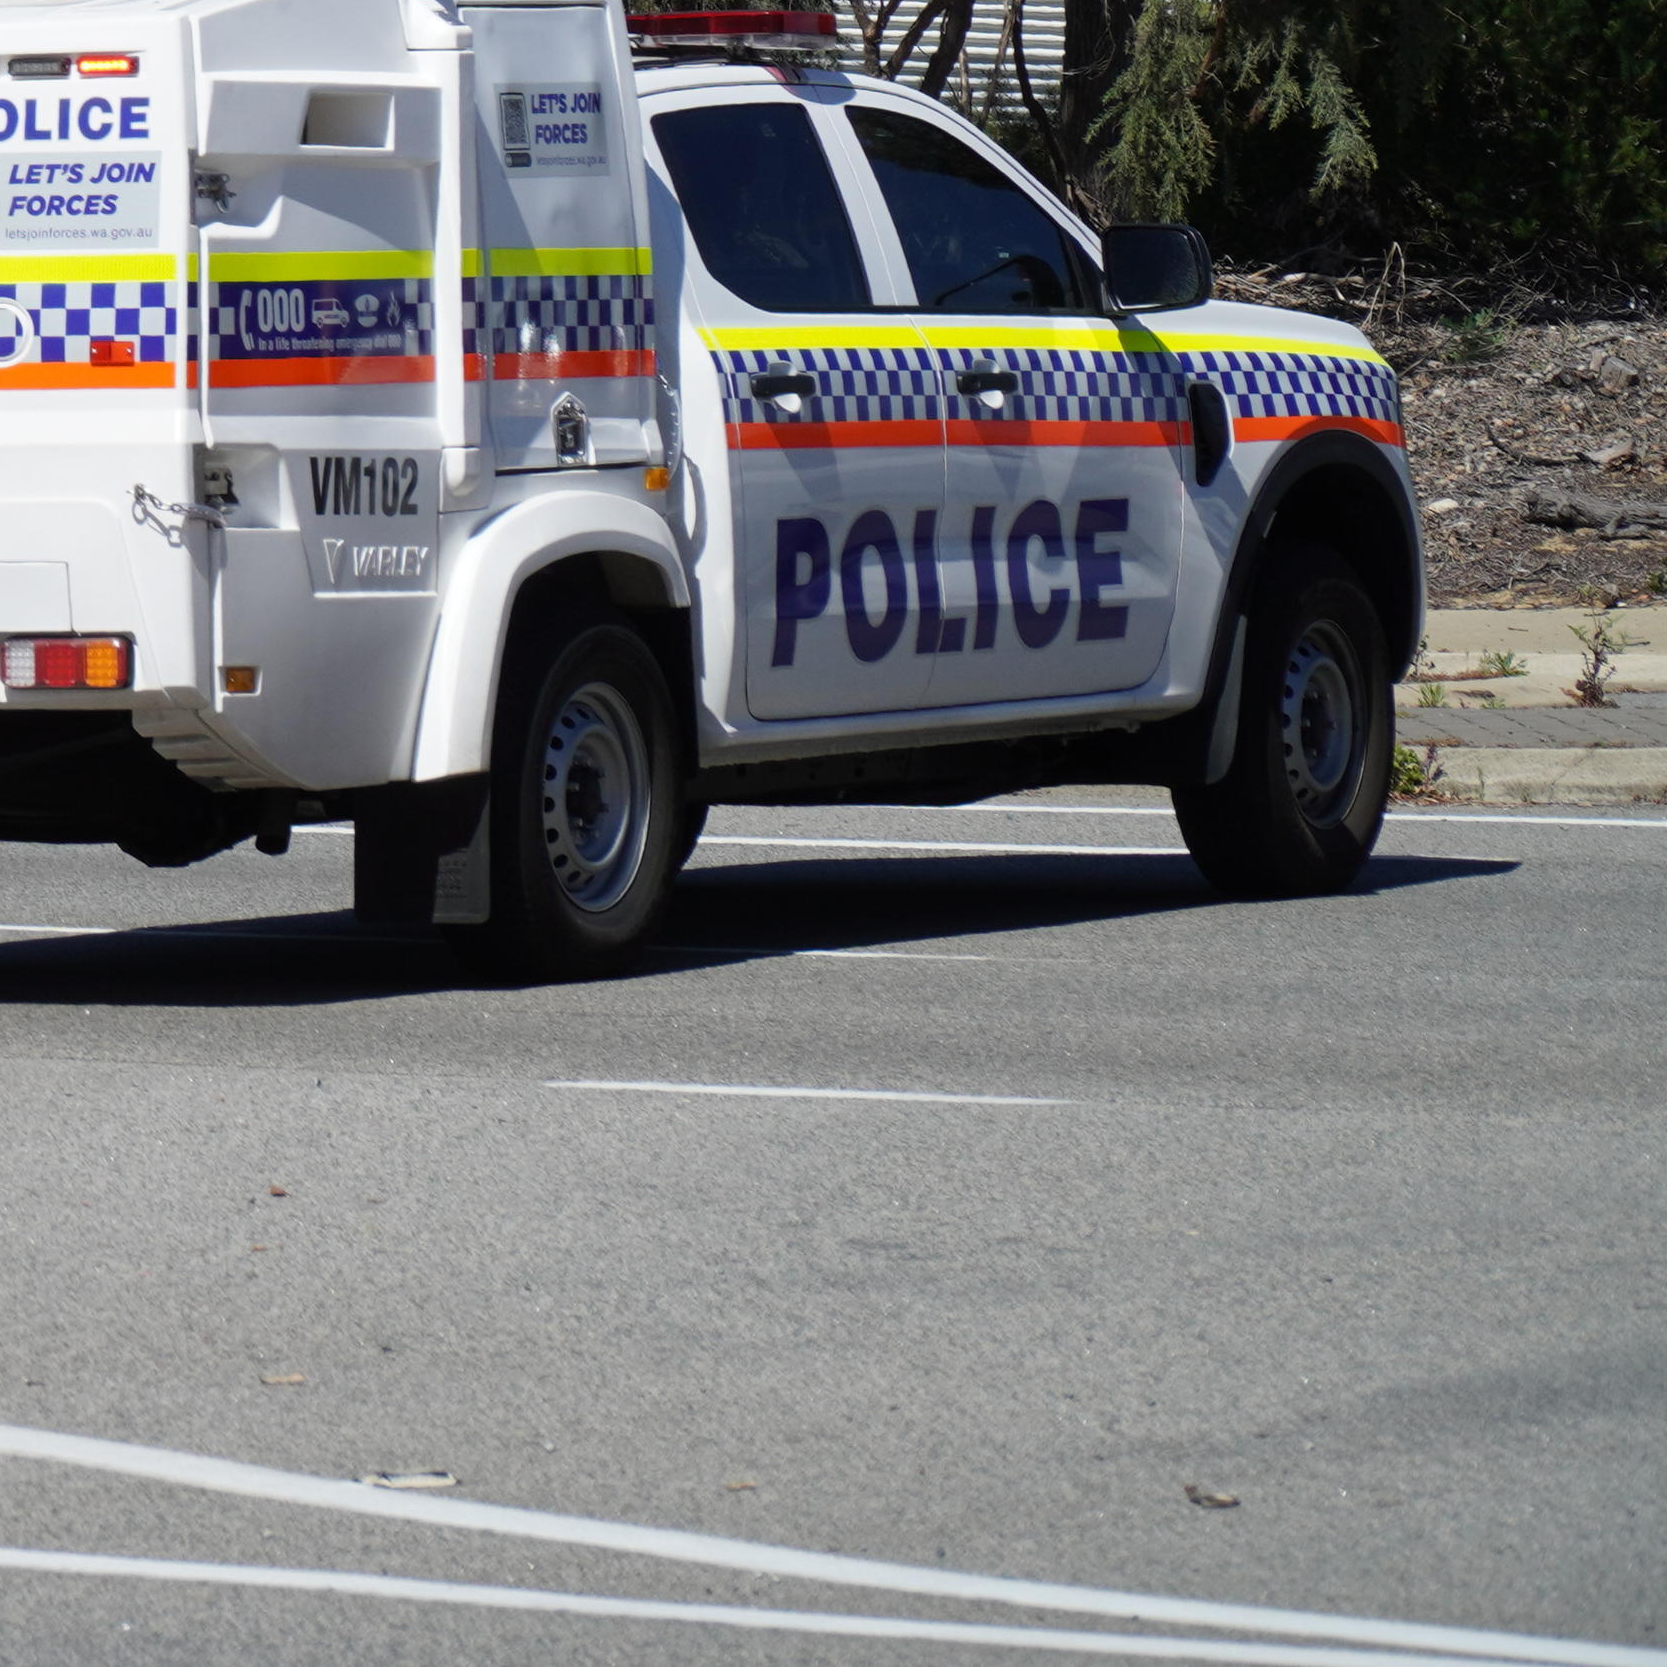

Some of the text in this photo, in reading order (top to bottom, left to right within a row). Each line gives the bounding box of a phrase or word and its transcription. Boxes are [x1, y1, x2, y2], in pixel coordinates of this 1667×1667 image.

[531, 92, 601, 114] LET'S JOIN
[535, 124, 588, 145] FORCES
[8, 162, 157, 185] LET'S JOIN
[8, 194, 119, 217] FORCES
[5, 226, 153, 242] letsjoinforces.wa.gov.au
[257, 288, 305, 333] 000
[309, 456, 419, 517] VM102
[352, 546, 429, 577] VARLEY
[771, 497, 1130, 667] POLICE
